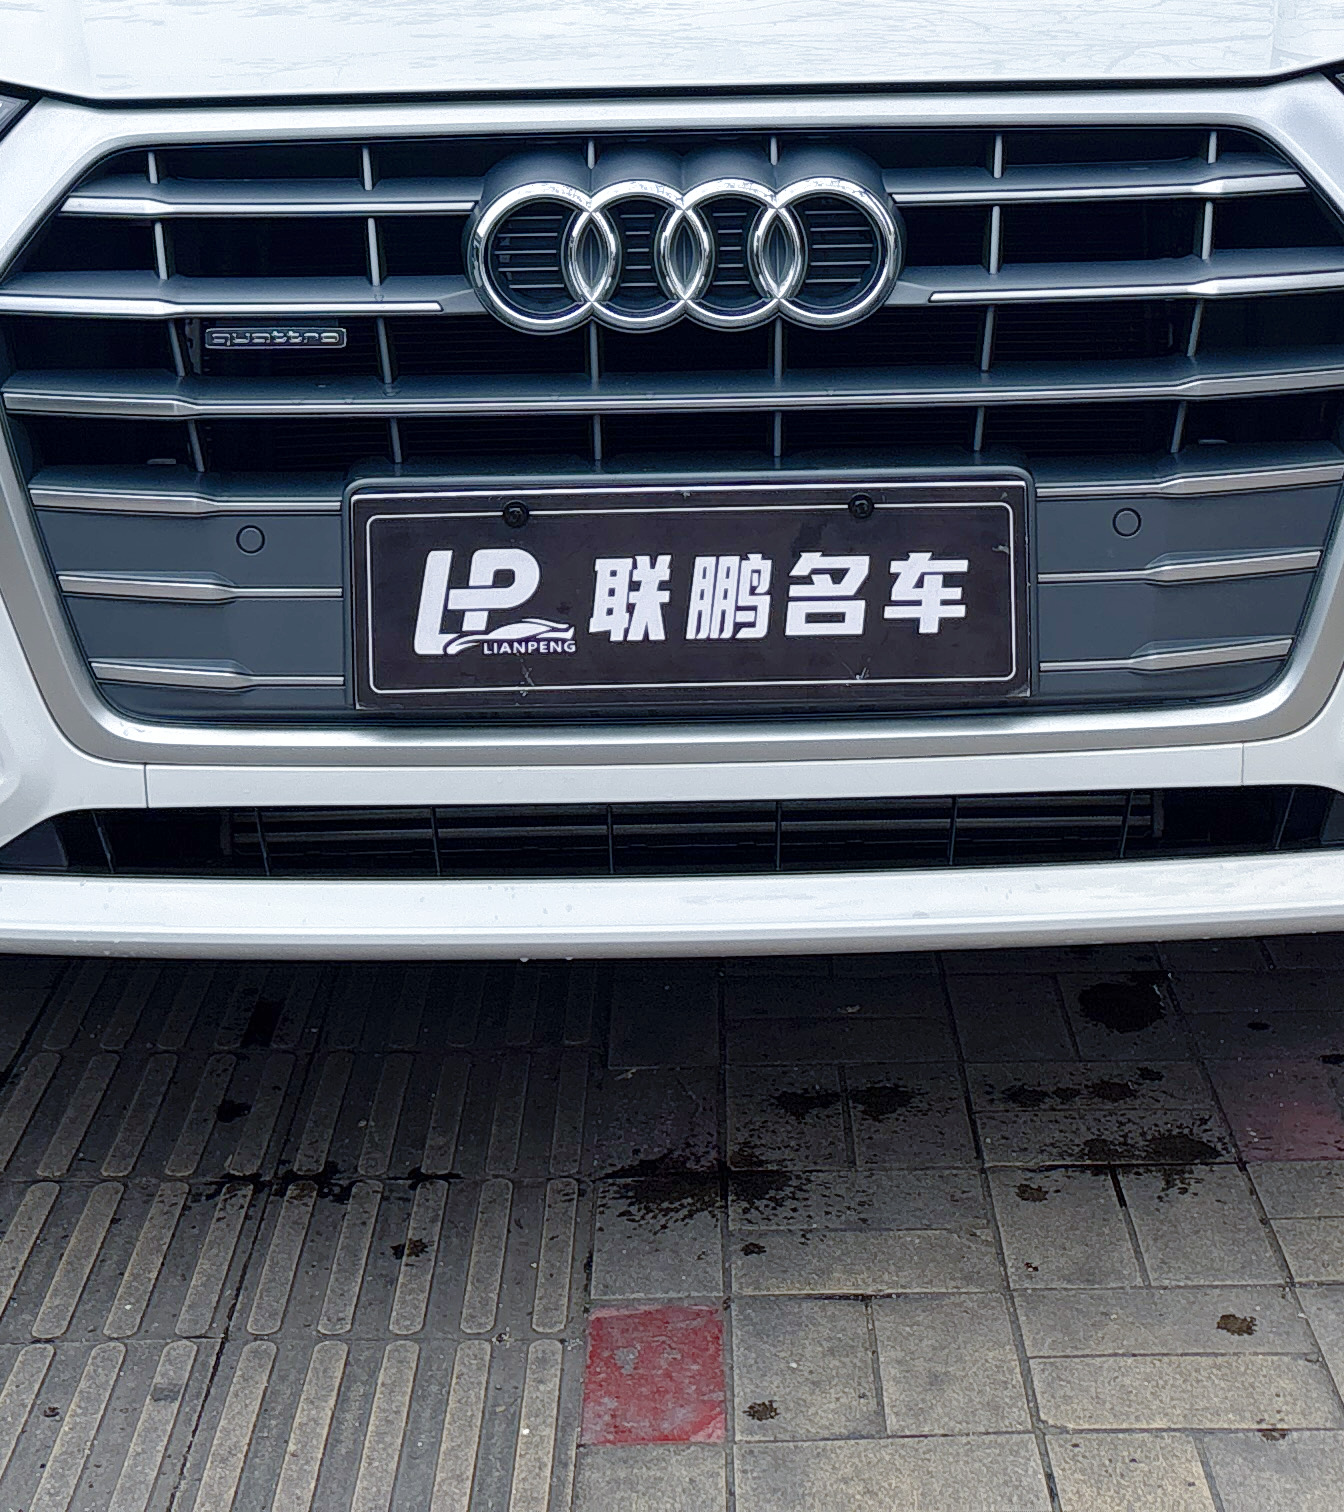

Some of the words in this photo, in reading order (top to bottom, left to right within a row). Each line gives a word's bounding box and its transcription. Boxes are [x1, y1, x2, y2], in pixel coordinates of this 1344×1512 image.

[211, 330, 340, 347] quattro
[588, 550, 970, 642] 联鹏名车
[482, 639, 577, 655] LIANPENG
